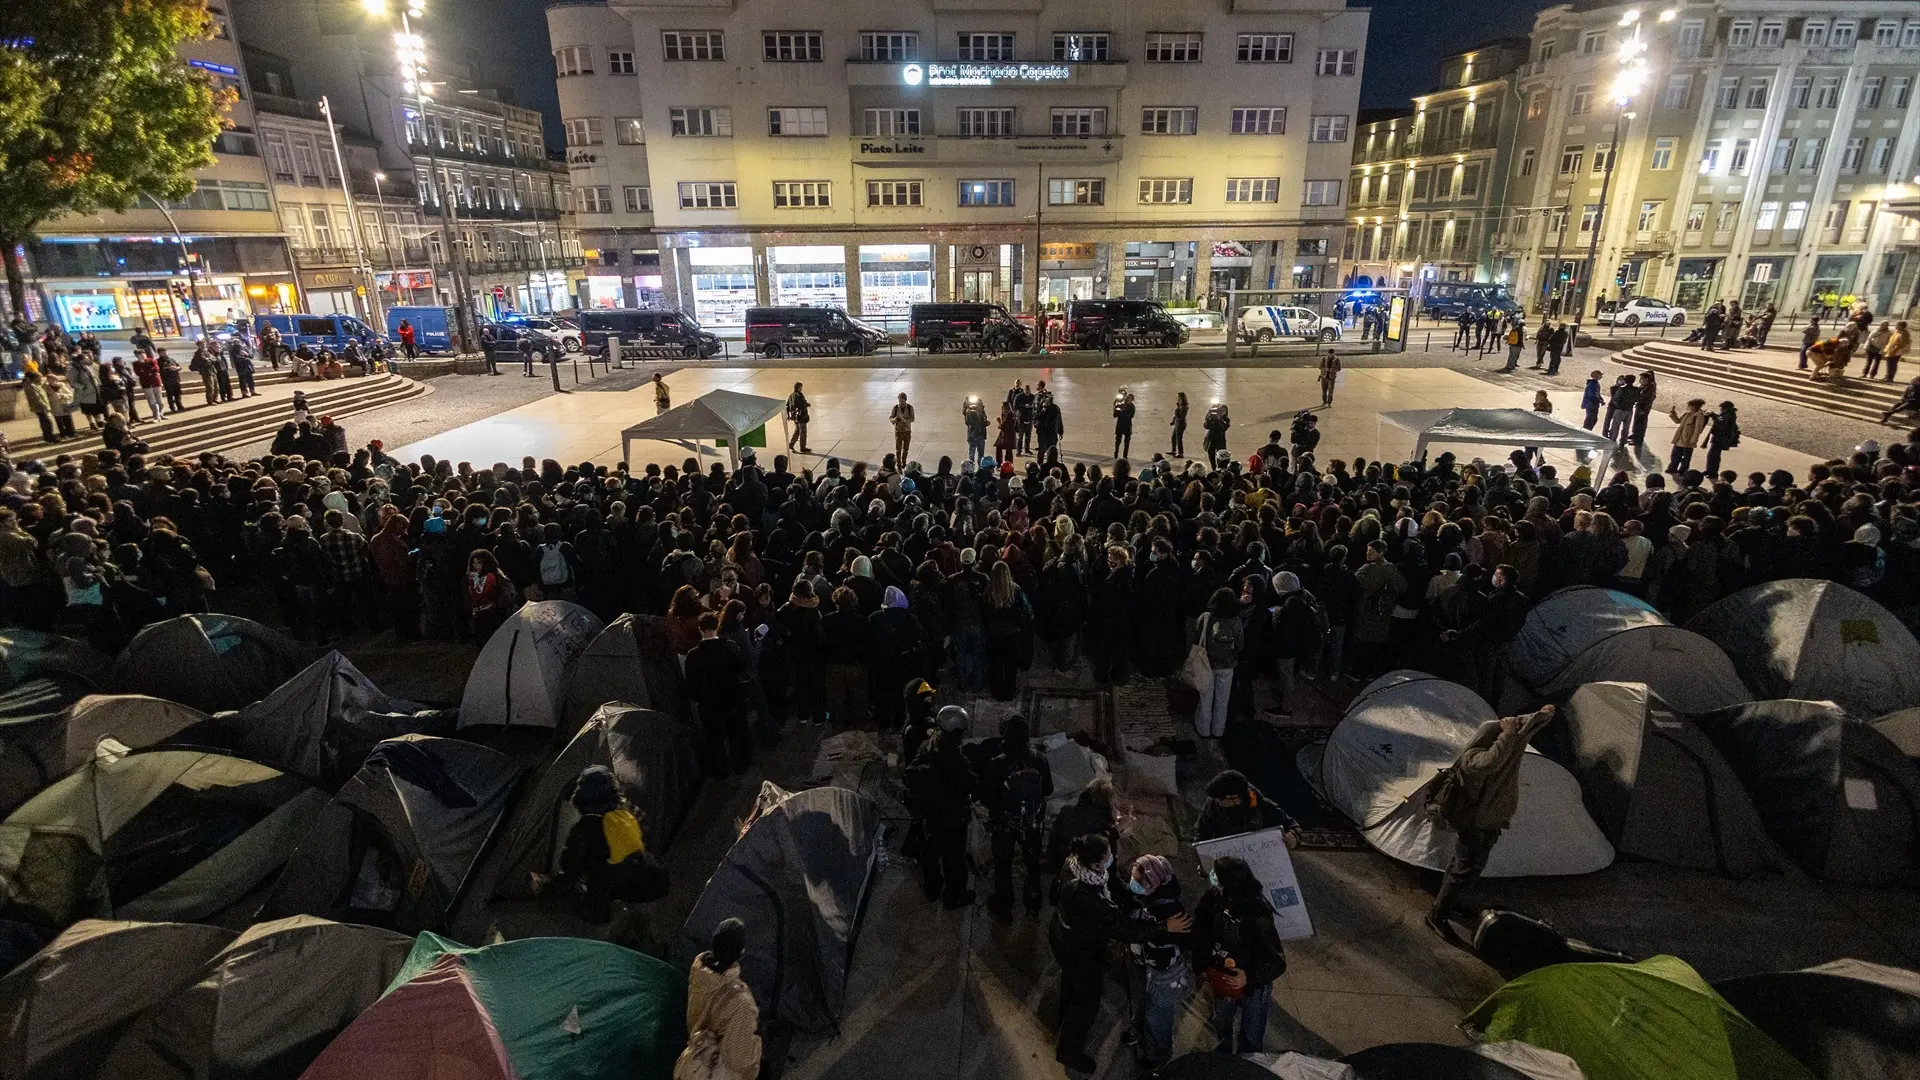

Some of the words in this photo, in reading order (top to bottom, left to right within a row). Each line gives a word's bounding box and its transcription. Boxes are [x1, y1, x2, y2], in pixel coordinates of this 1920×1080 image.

[959, 64, 1017, 79] Machado
[1018, 64, 1069, 80] Capelas
[860, 143, 892, 154] Pinto
[895, 143, 924, 154] Leite
